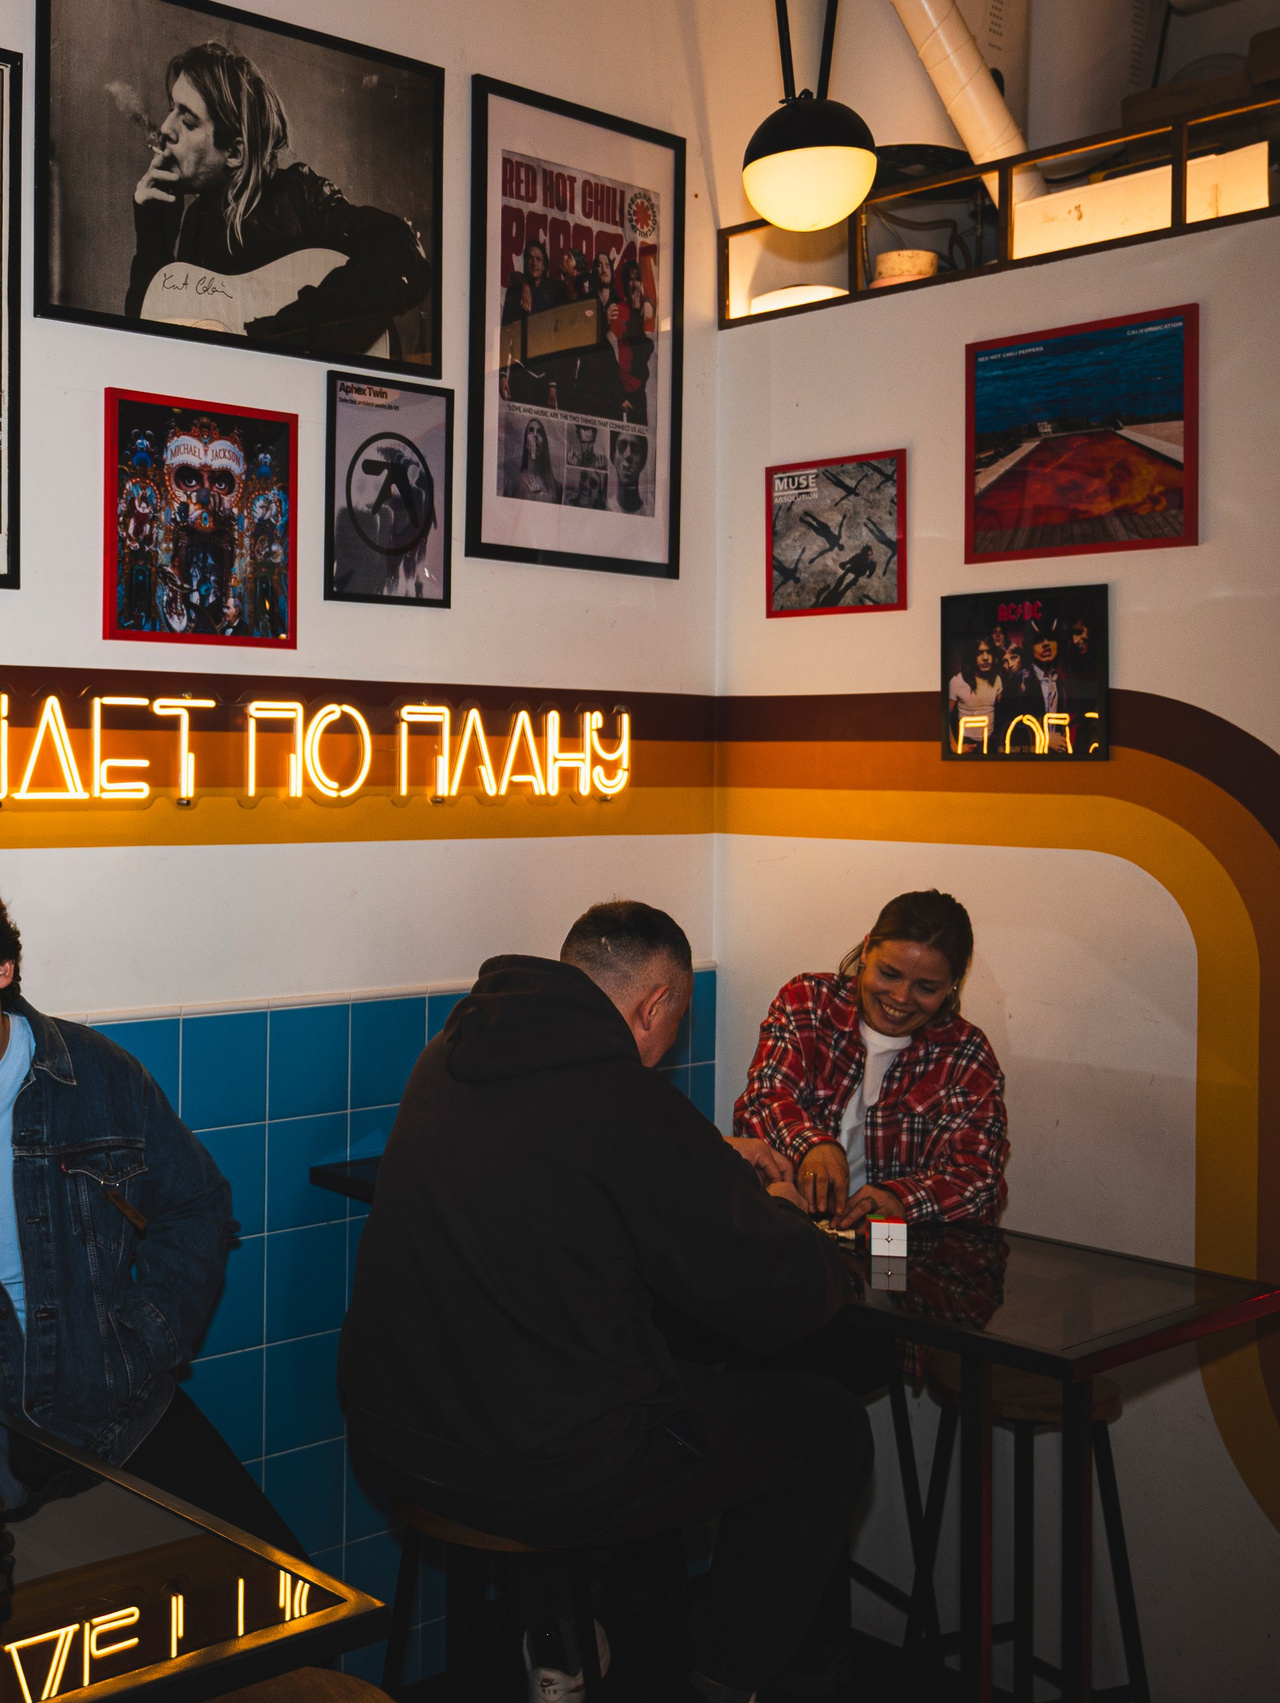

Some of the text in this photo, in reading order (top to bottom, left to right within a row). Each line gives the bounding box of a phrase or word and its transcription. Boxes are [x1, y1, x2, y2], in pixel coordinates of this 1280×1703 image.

[501, 156, 625, 229] RED HOT CHILI
[990, 353, 1001, 361] HOT
[339, 382, 388, 400] Aphex Twin
[170, 443, 240, 467] MICHAEL JACKSON
[774, 474, 817, 491] MUSE
[248, 700, 372, 798] ПО
[399, 704, 631, 798] ПЛАНУ
